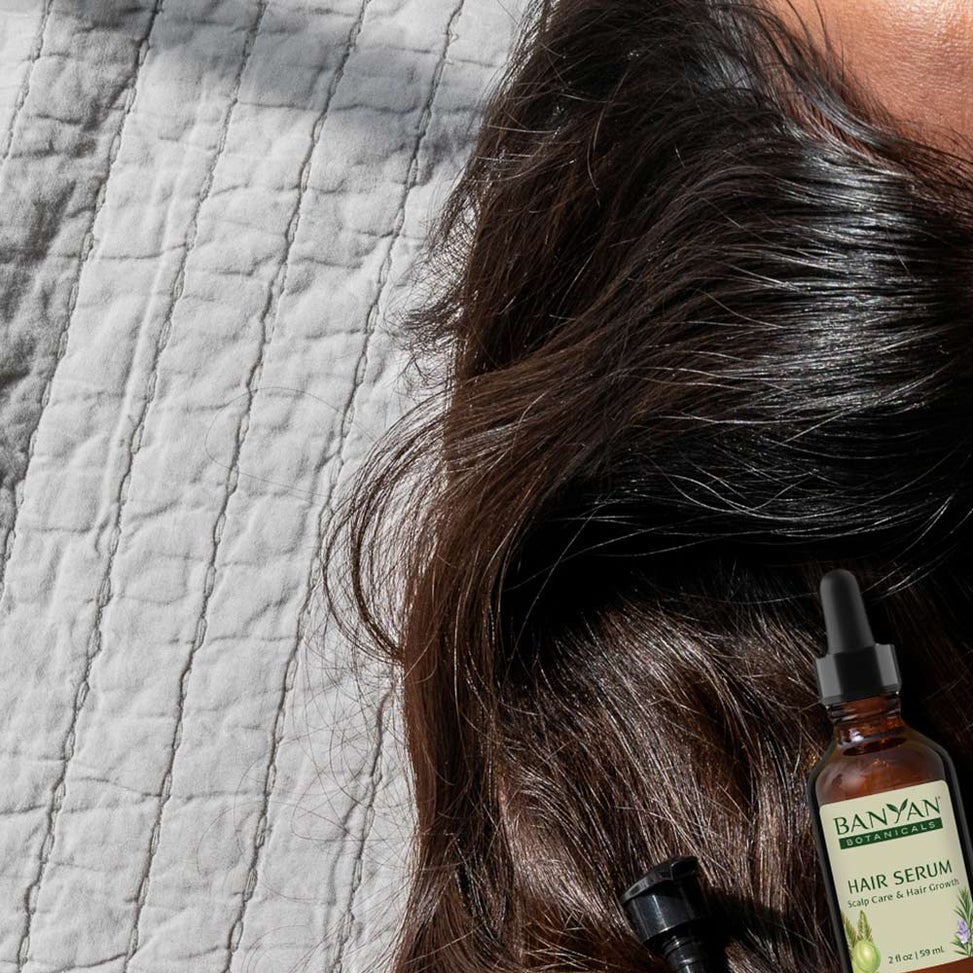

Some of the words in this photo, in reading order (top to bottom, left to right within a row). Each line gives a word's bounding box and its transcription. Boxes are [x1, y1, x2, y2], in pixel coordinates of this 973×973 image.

[833, 797, 941, 835] BANYAN
[846, 821, 936, 847] BOTANICALS
[848, 874, 888, 894] HAIR
[893, 860, 953, 885] SERUM
[848, 898, 870, 908] Scalp
[871, 894, 893, 904] Care
[896, 891, 904, 899] &
[906, 886, 927, 897] Hair
[929, 878, 960, 892] Growth
[888, 956, 894, 964] 2
[895, 954, 901, 963] fl
[904, 953, 913, 961] oz
[920, 948, 931, 958] 59
